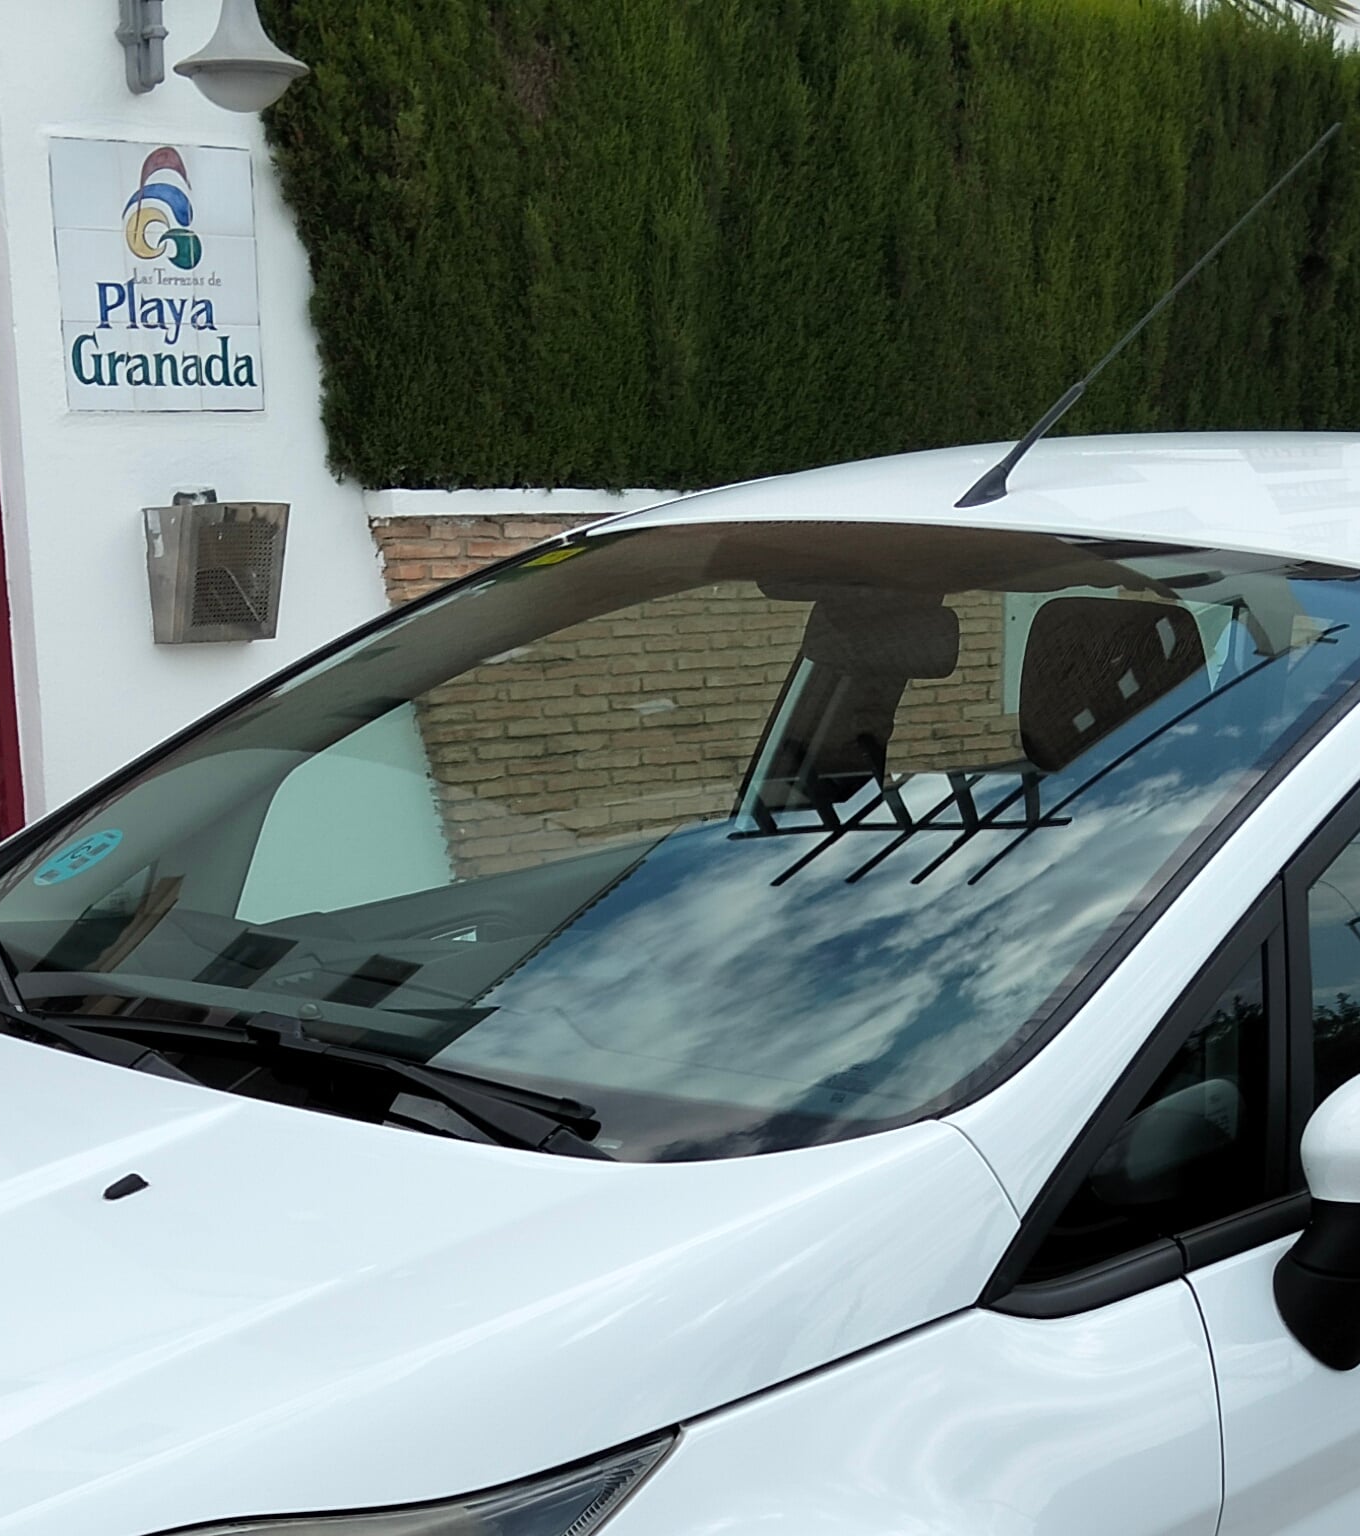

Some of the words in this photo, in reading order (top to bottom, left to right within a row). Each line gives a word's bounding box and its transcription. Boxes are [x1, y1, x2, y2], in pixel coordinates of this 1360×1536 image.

[133, 267, 153, 285] Las
[153, 267, 204, 287] Terrazas
[208, 271, 222, 287] de
[96, 280, 217, 345] Playa
[71, 332, 257, 387] Granada
